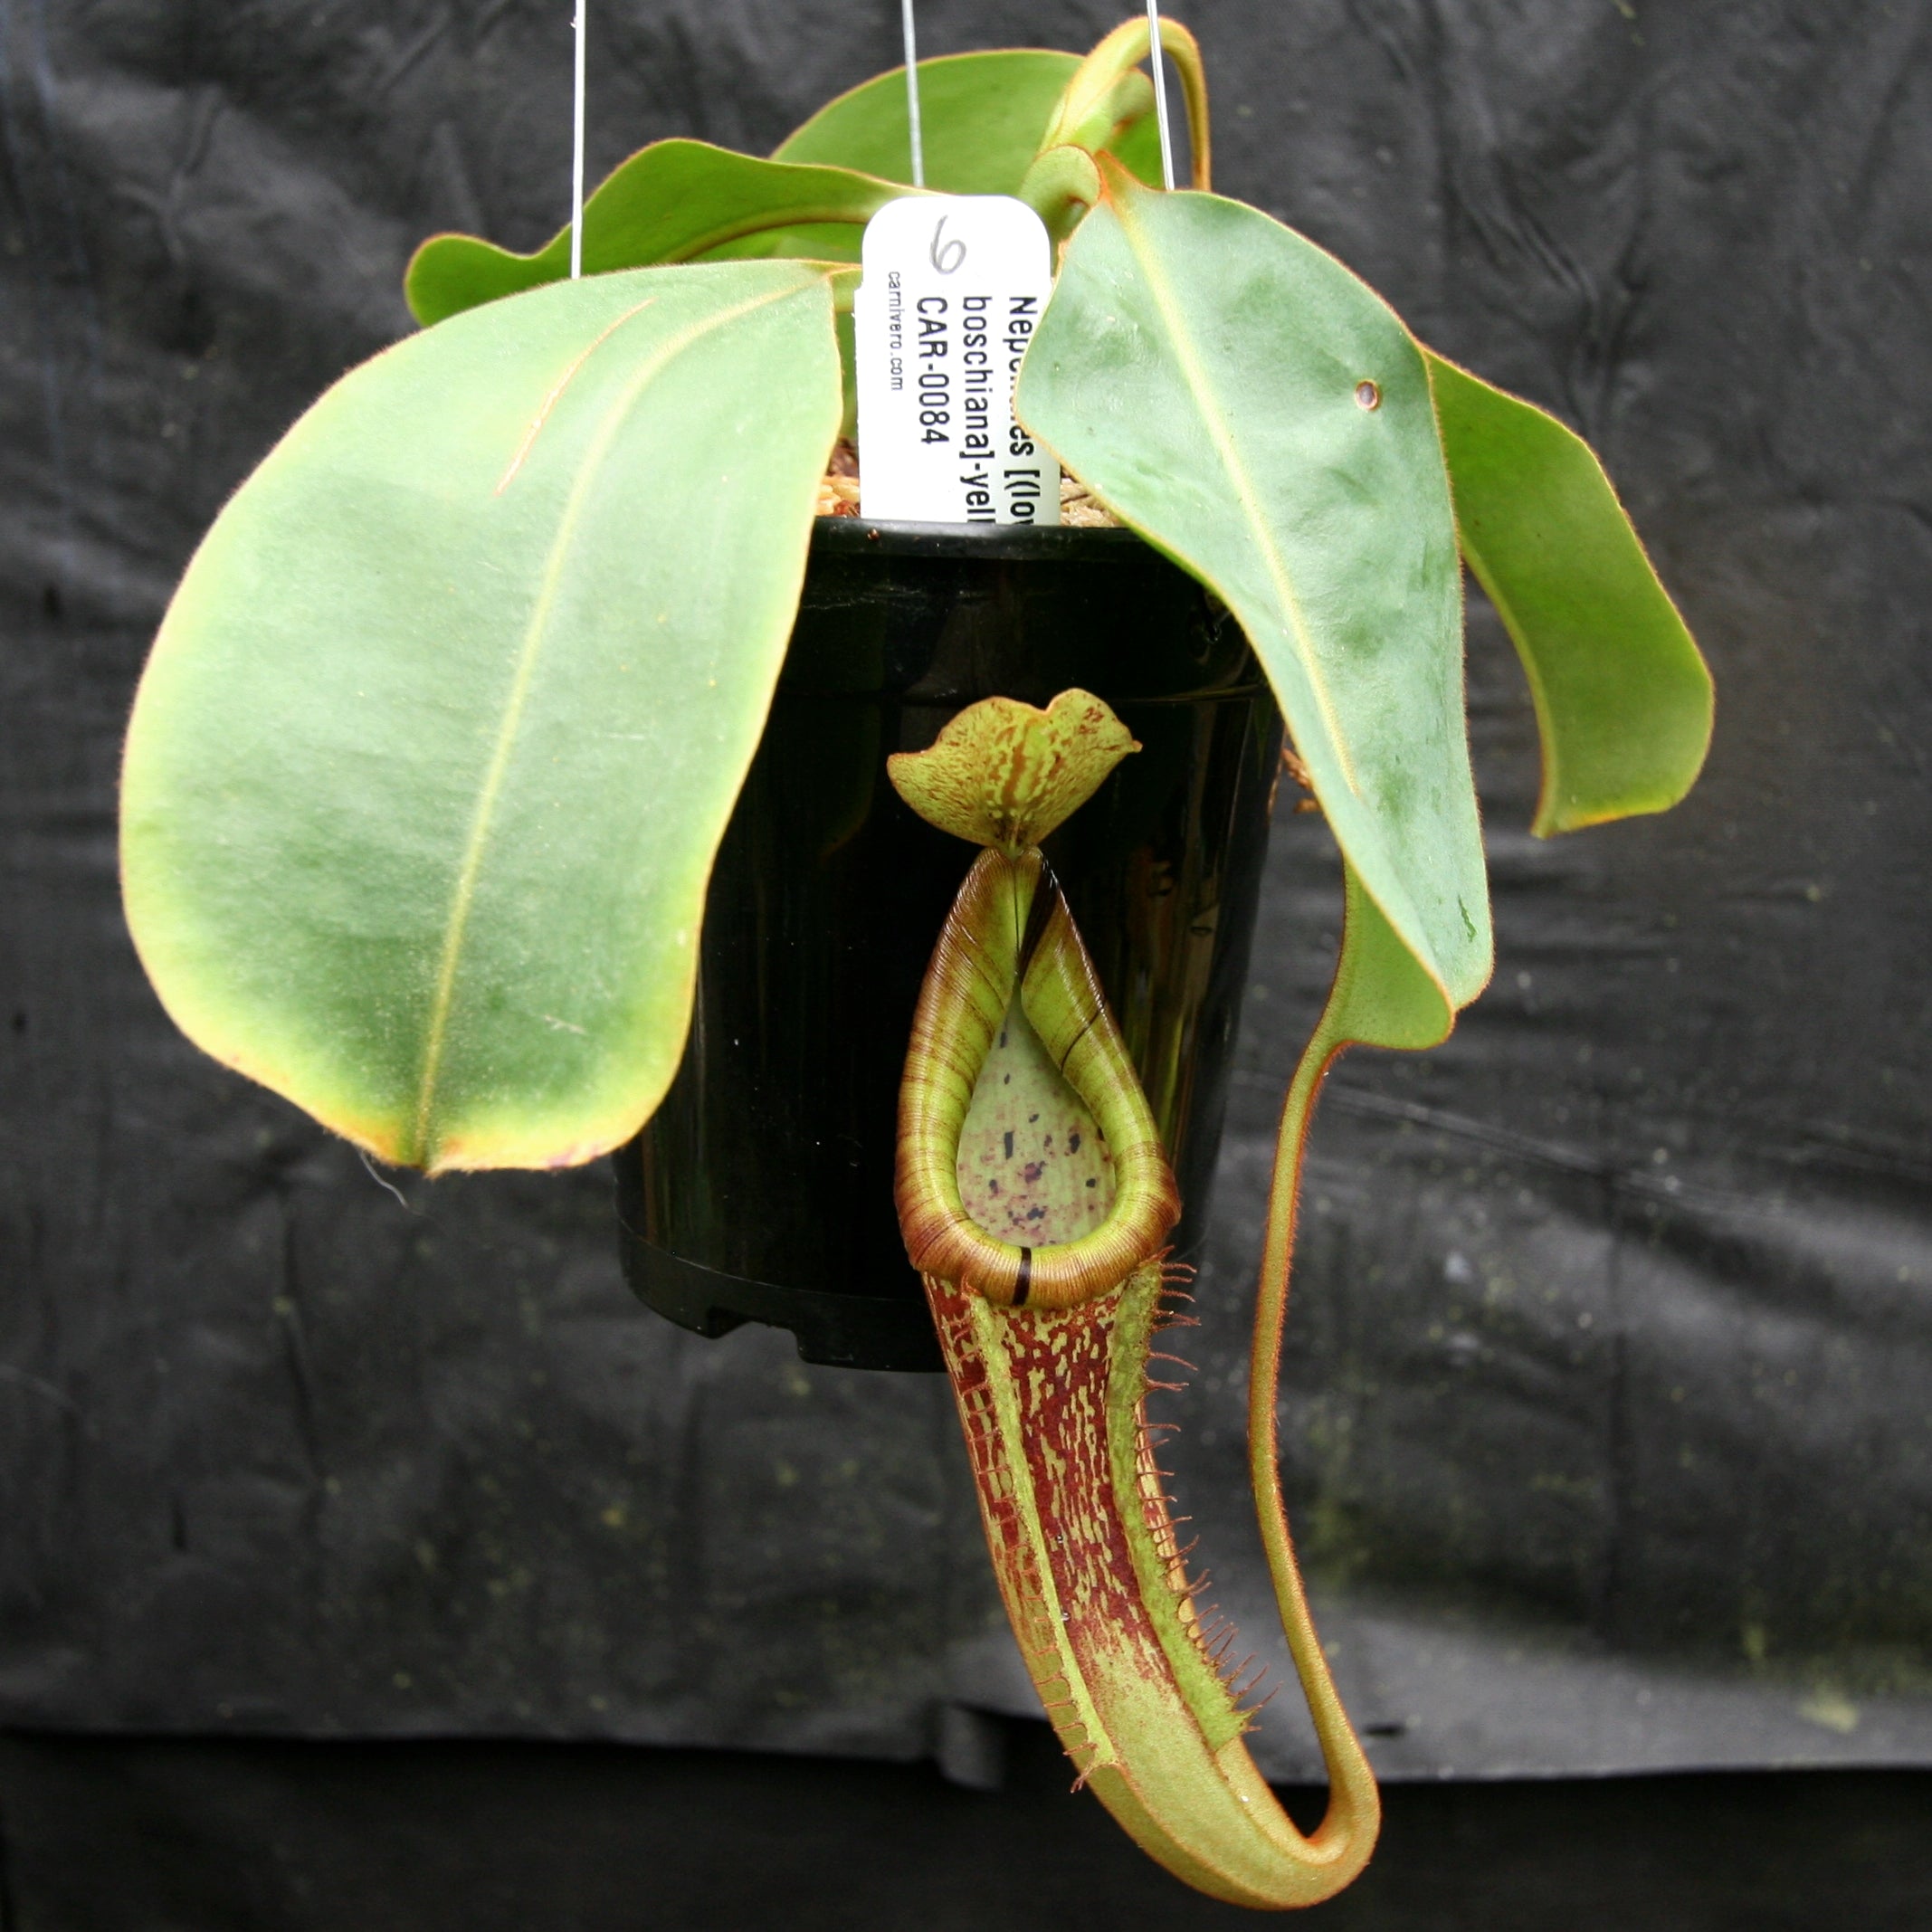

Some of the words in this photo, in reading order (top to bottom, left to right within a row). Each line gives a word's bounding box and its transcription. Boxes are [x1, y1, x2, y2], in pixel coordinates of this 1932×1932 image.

[929, 214, 966, 274] 6
[888, 271, 903, 391] carnivero.com
[917, 297, 950, 444] CAR-0084
